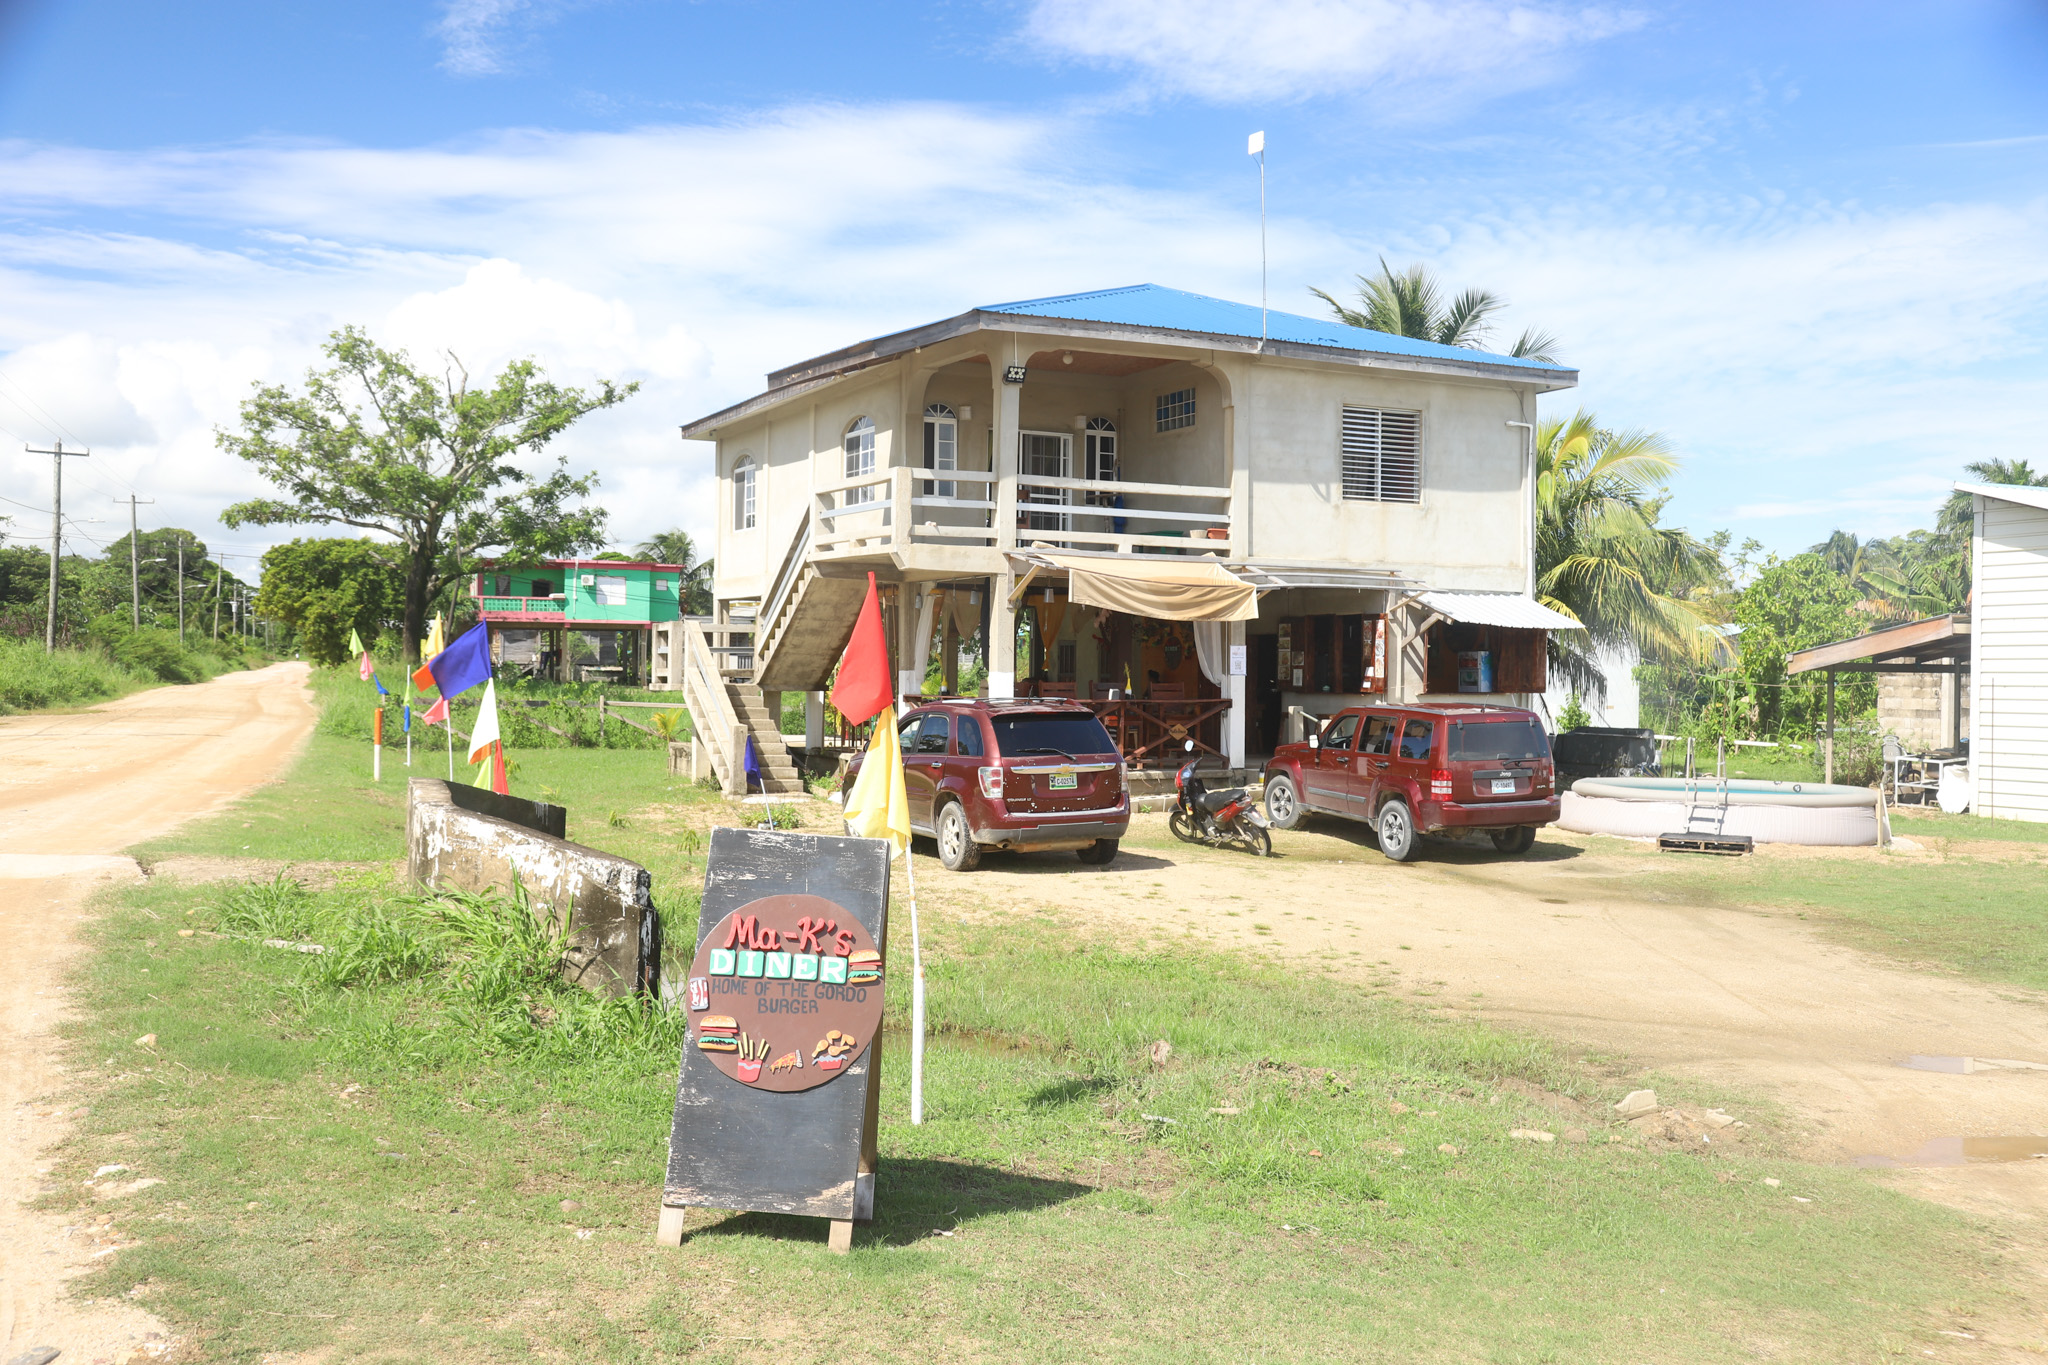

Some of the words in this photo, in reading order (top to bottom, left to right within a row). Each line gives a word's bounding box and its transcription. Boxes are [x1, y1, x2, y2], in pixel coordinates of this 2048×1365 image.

[724, 913, 854, 957] Ma-K's
[710, 948, 848, 983] DINER
[711, 978, 749, 996] HOME
[754, 981, 771, 997] OF
[777, 982, 810, 998] THE
[814, 984, 868, 1003] GORDO
[757, 999, 820, 1014] BURGER
